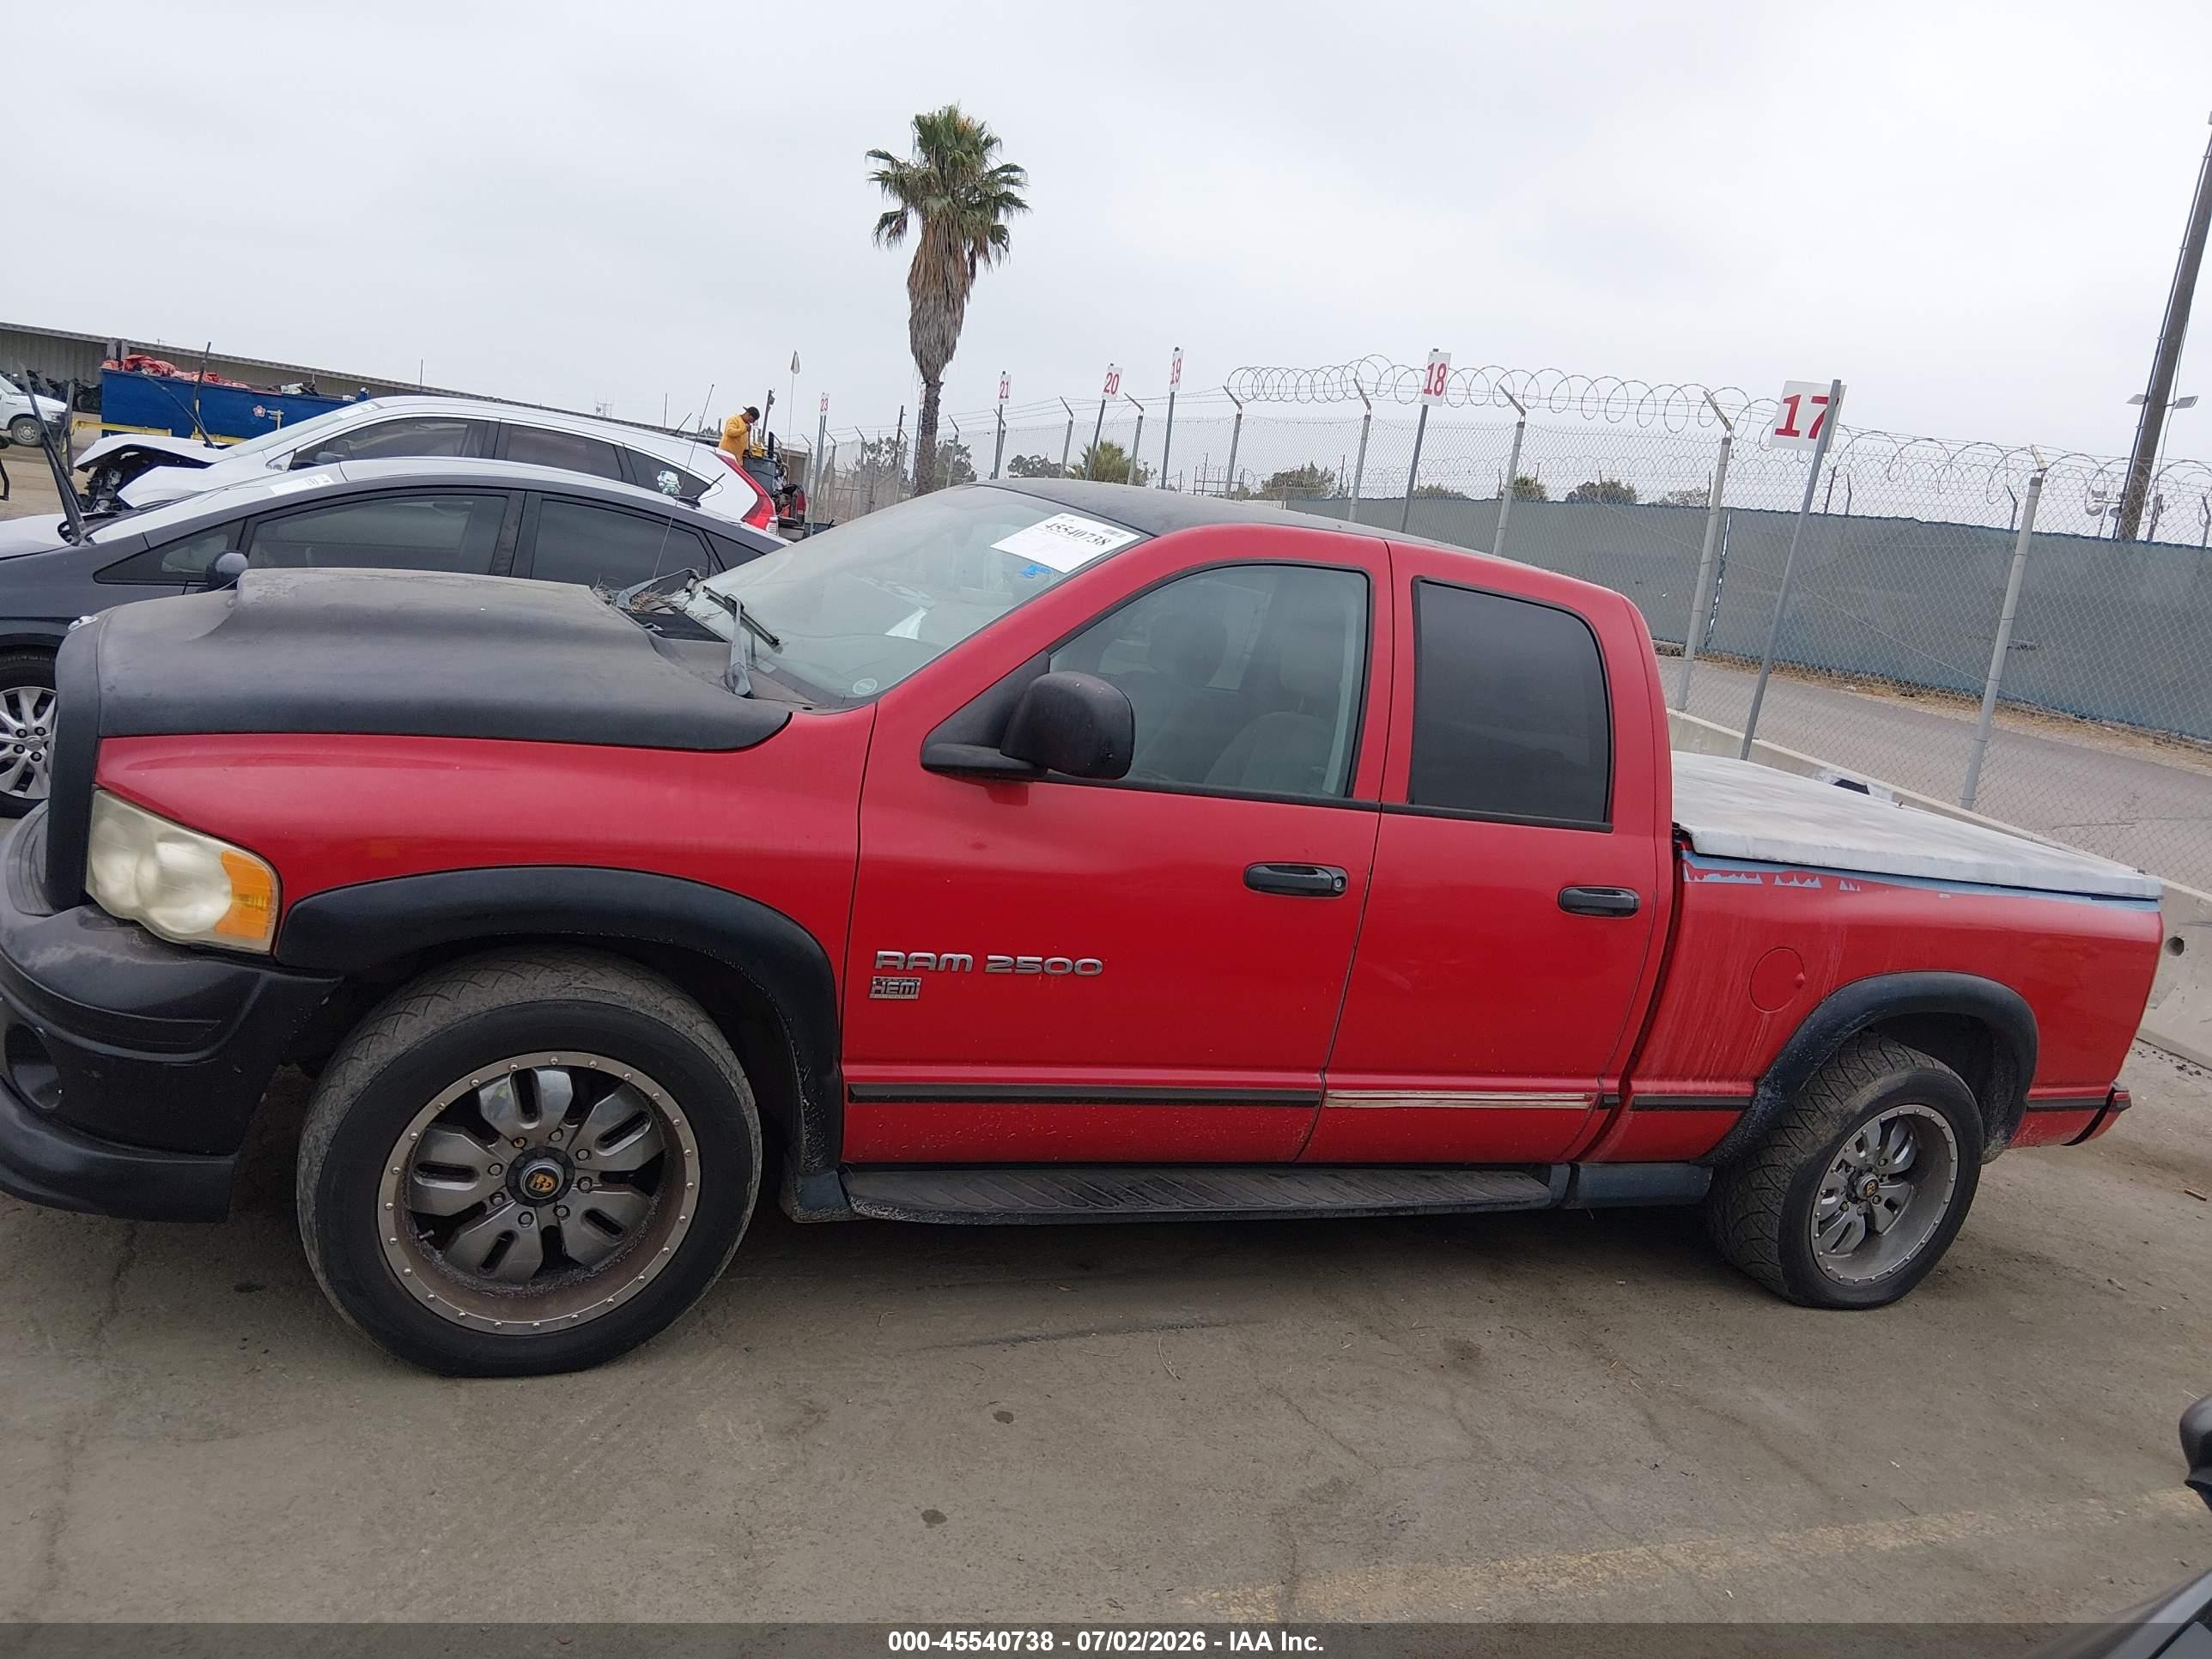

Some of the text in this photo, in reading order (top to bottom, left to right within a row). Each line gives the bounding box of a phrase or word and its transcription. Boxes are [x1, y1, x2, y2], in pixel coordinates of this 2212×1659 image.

[1103, 372, 1120, 394] 20
[1170, 358, 1182, 386] 19
[1423, 362, 1447, 397] 18
[1000, 380, 1010, 398] 21
[820, 398, 829, 411] 23
[1775, 394, 1839, 440] 17
[1044, 522, 1112, 546] 45540738
[874, 950, 1104, 977] RAM 2500
